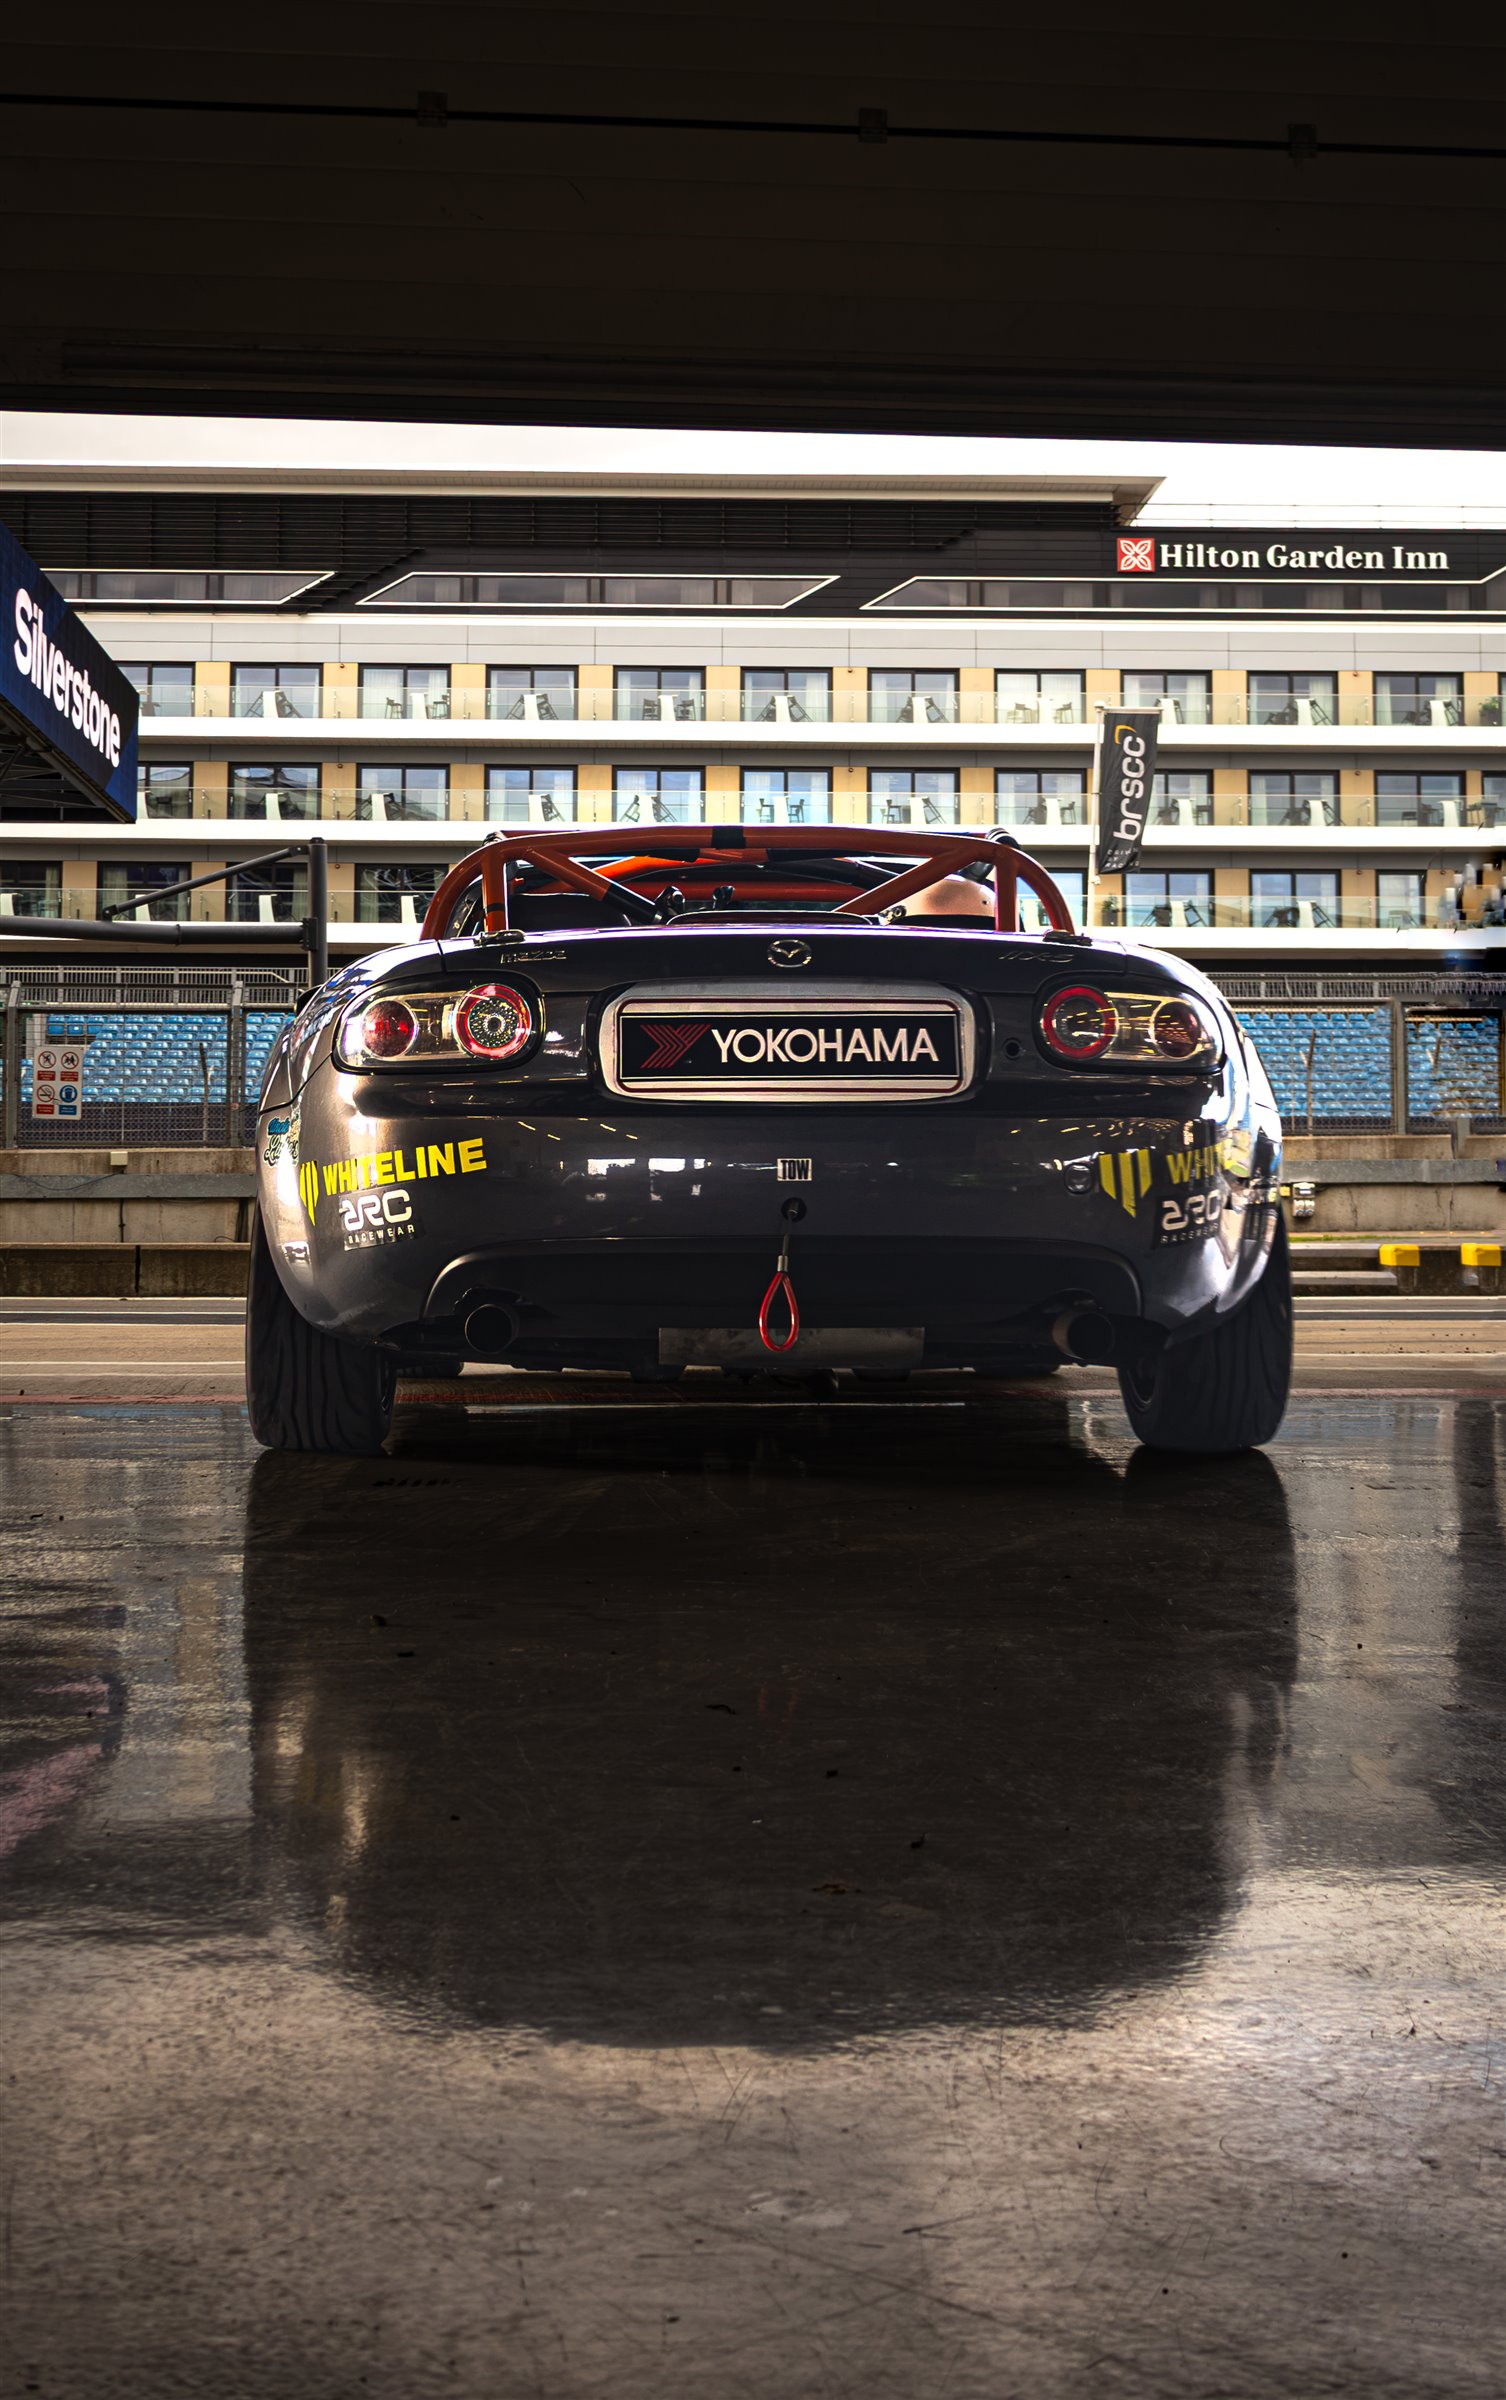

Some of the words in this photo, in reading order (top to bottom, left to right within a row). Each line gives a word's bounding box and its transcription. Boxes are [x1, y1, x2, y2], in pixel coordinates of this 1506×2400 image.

[1159, 543, 1260, 568] Hilton
[1266, 544, 1386, 570] Garden
[1392, 546, 1450, 570] Inn
[13, 588, 121, 768] Silverstone
[1112, 735, 1146, 841] brscc
[711, 1028, 940, 1063] YOKOHAMA
[322, 1137, 488, 1196] WHITELINE
[780, 1159, 810, 1180] TOW
[348, 1224, 415, 1244] RACEWEAR
